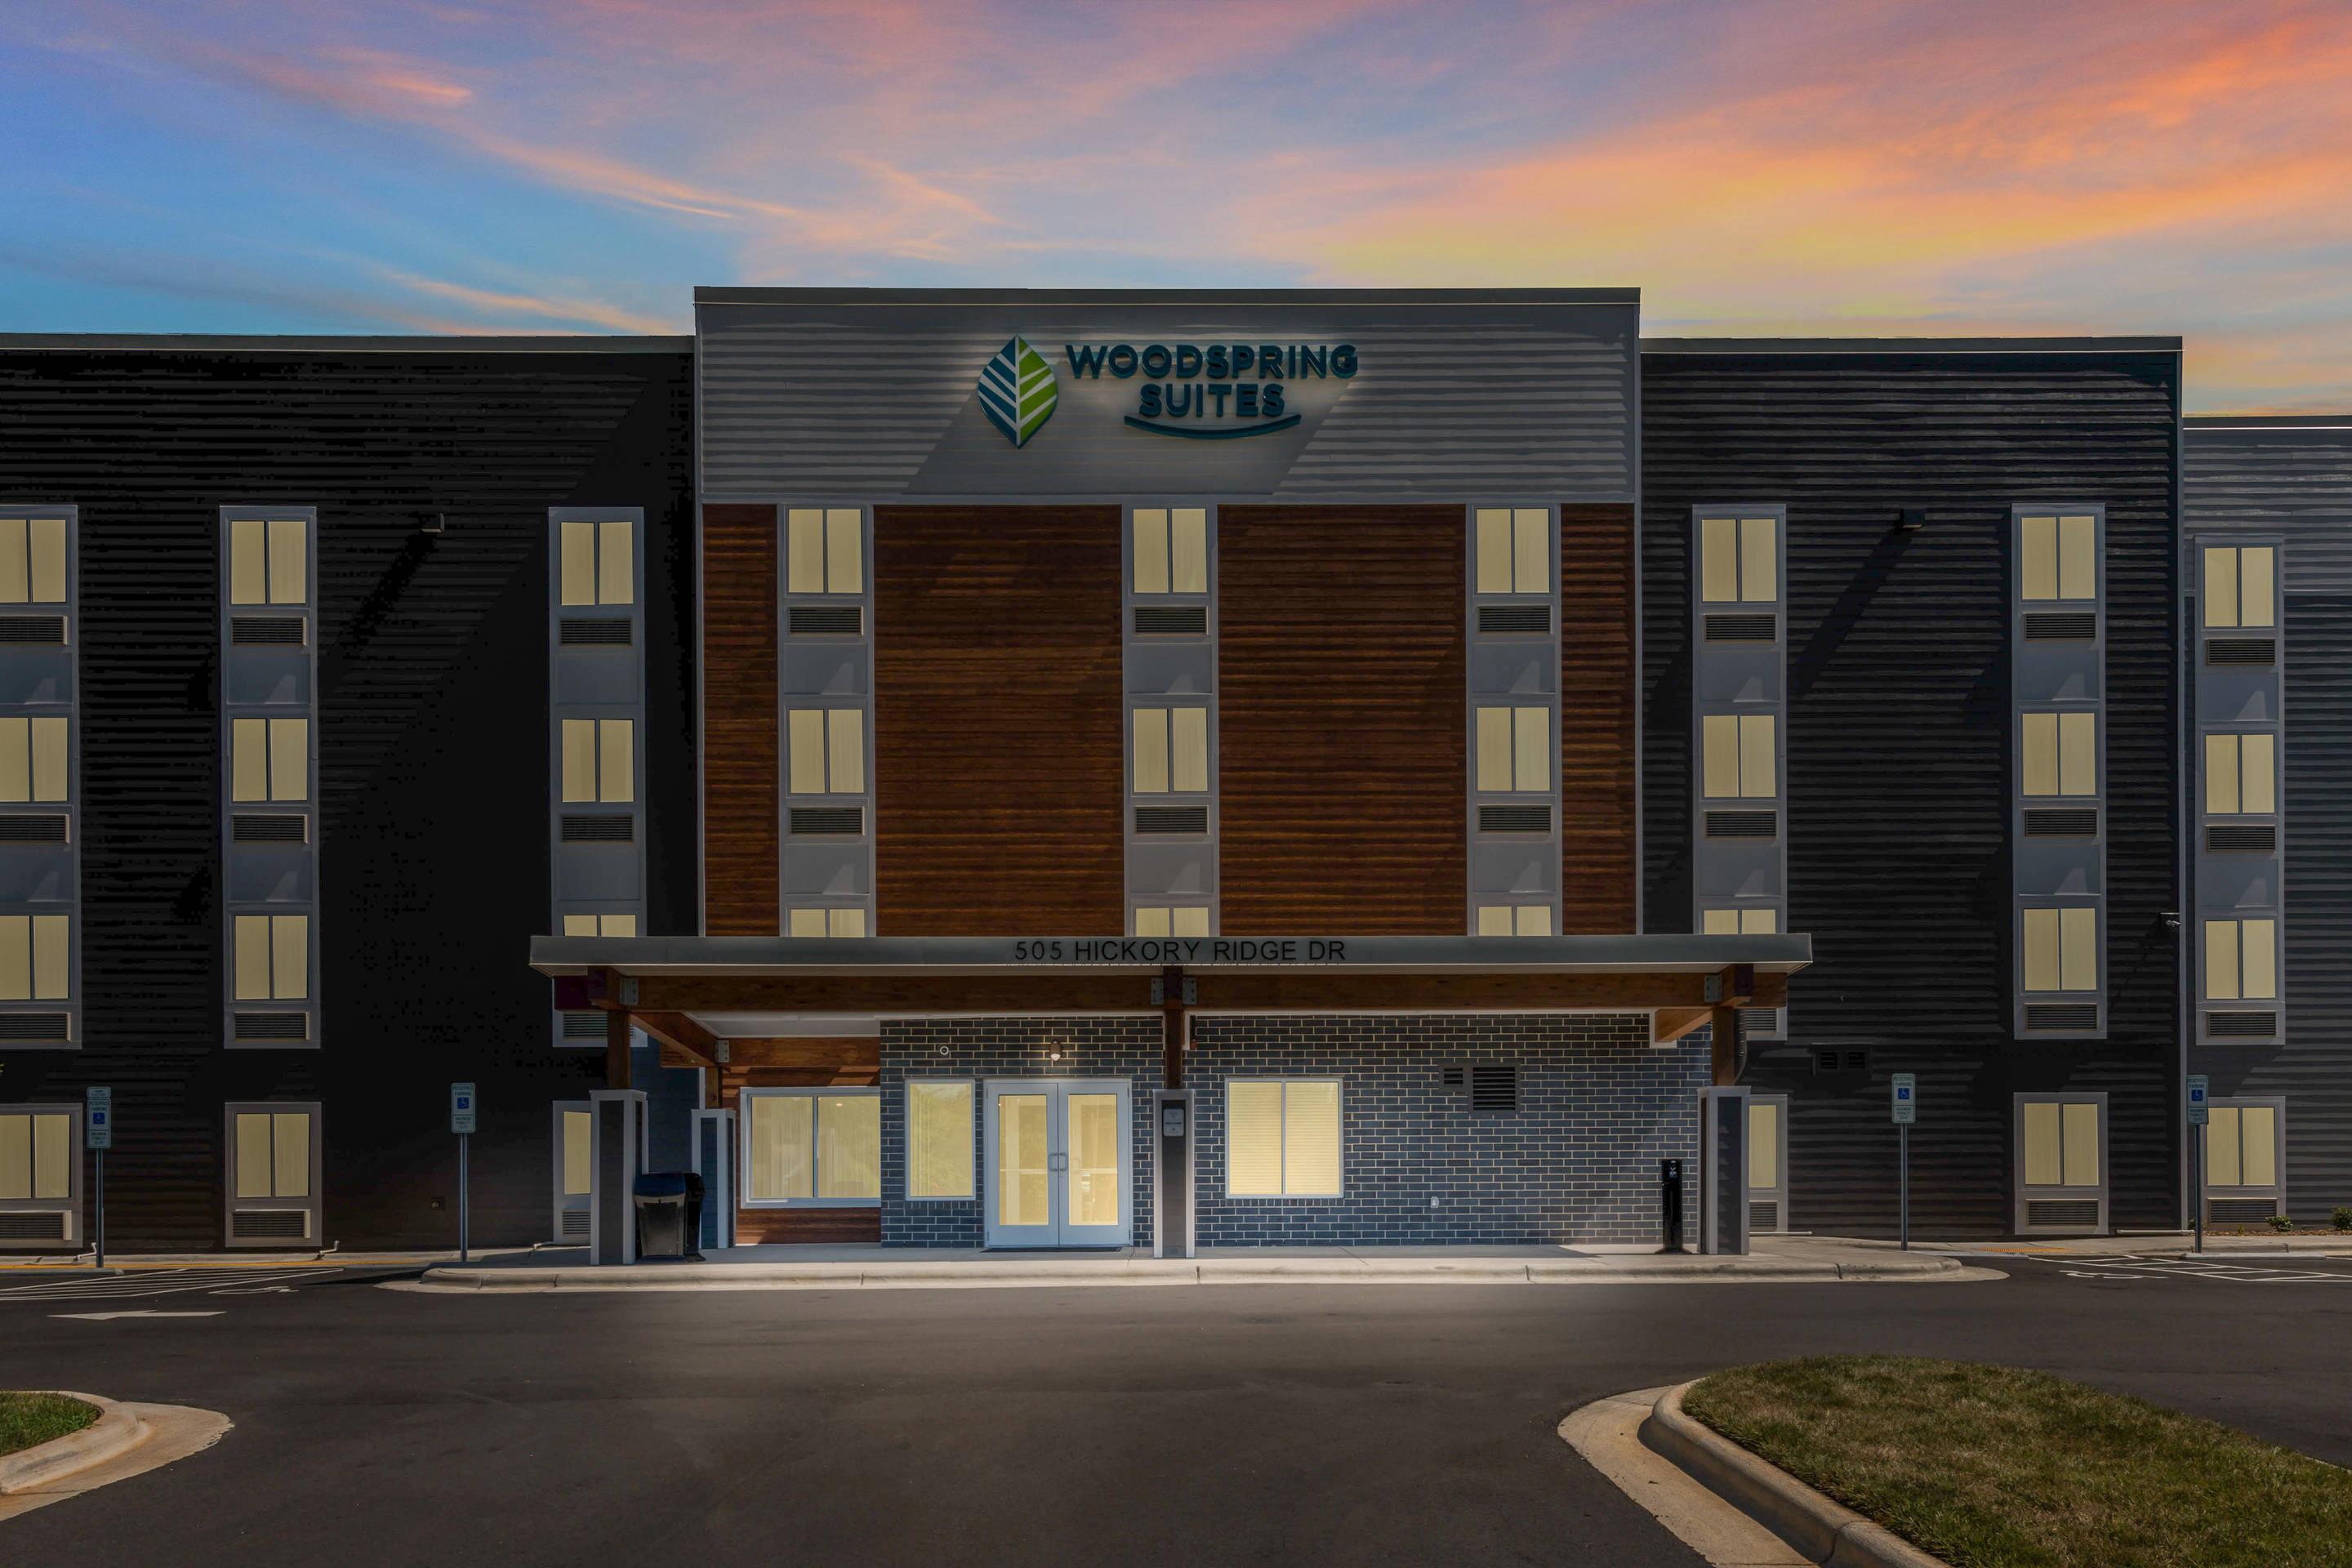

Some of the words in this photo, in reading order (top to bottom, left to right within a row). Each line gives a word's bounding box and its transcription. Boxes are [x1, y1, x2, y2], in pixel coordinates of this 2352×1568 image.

[1065, 344, 1359, 379] WOODSPRING
[1139, 383, 1285, 417] SUITES
[1015, 941, 1062, 960] 505
[1075, 941, 1200, 960] HICKORY
[1214, 941, 1297, 960] RIDGE
[1309, 941, 1346, 960] DR
